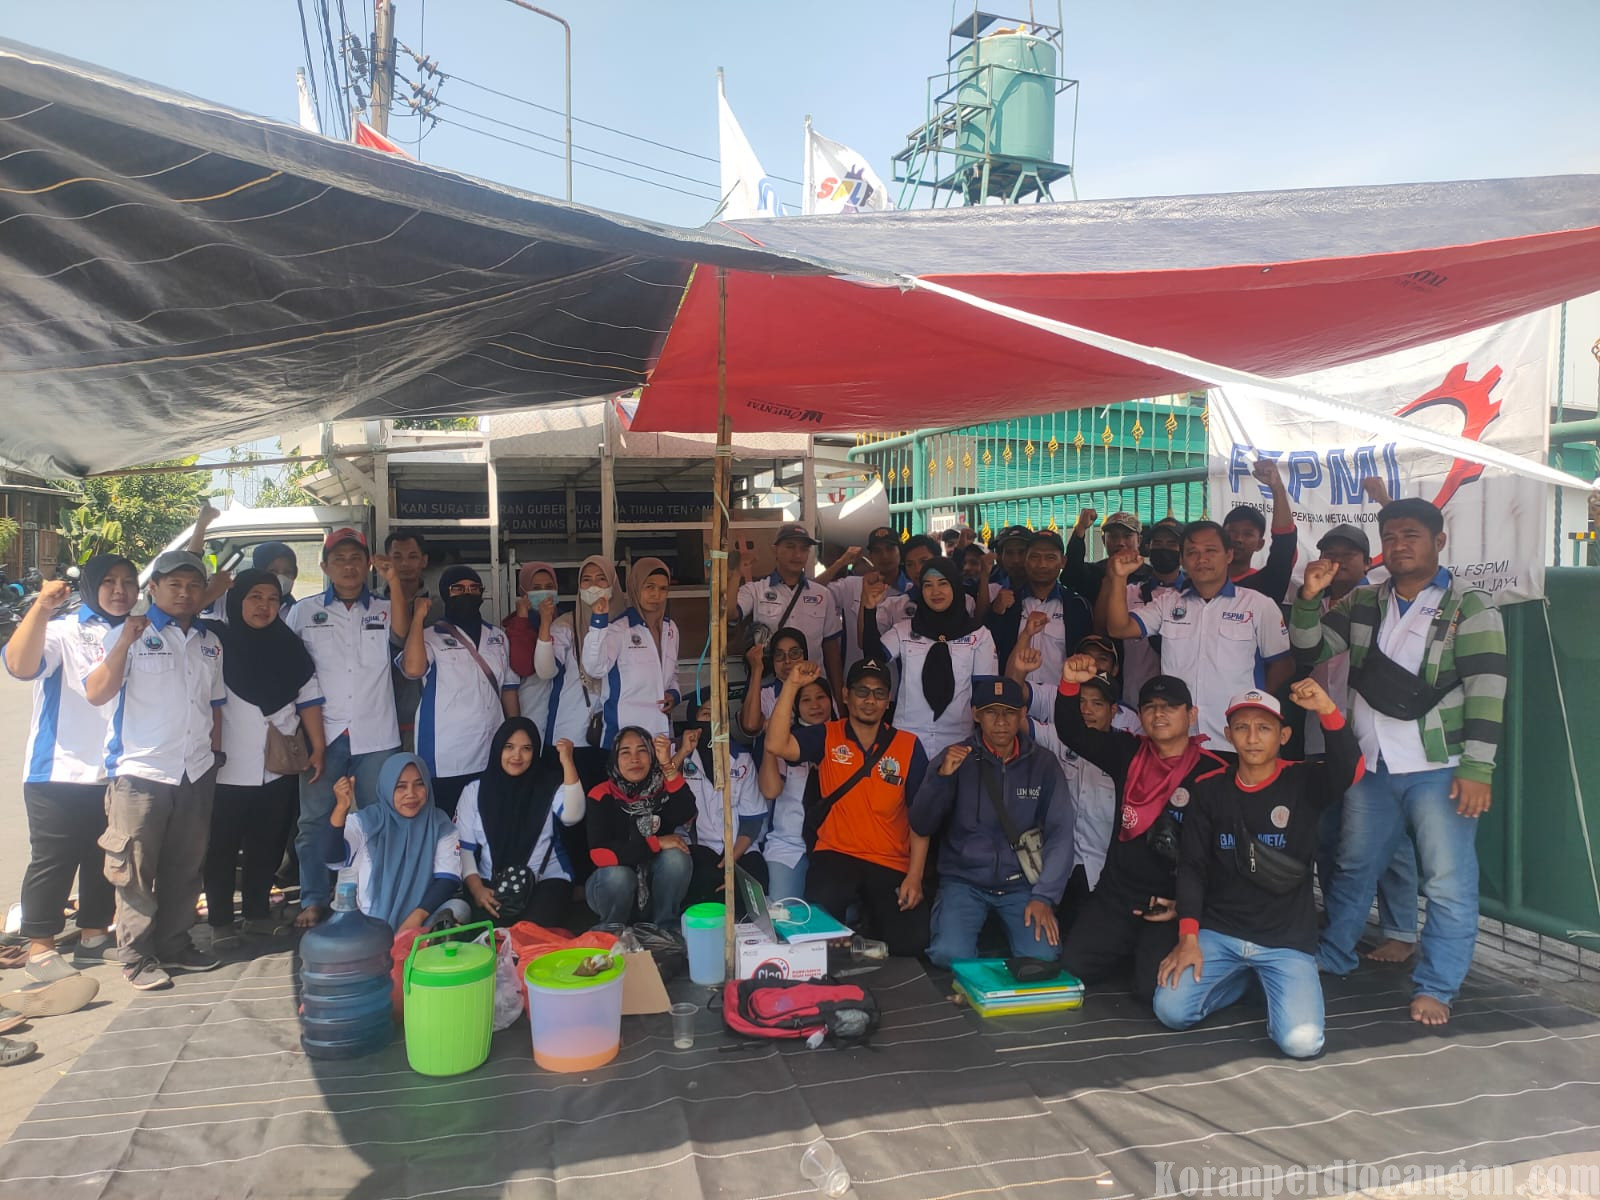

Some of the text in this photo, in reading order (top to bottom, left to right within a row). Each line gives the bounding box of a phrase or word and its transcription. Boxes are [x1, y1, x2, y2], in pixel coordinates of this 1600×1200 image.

[431, 503, 472, 514] SURAT
[474, 504, 523, 515] EDRAN
[527, 504, 594, 515] GUBERUR
[595, 504, 628, 515] JA
[629, 504, 665, 516] TIMUR
[1326, 513, 1353, 523] METAL
[1354, 512, 1379, 523] INDON
[512, 519, 537, 530] DAN
[540, 519, 568, 530] UMS
[577, 519, 603, 530] TAH
[1464, 560, 1510, 577] FSPMI
[1222, 611, 1245, 621] FSPMI
